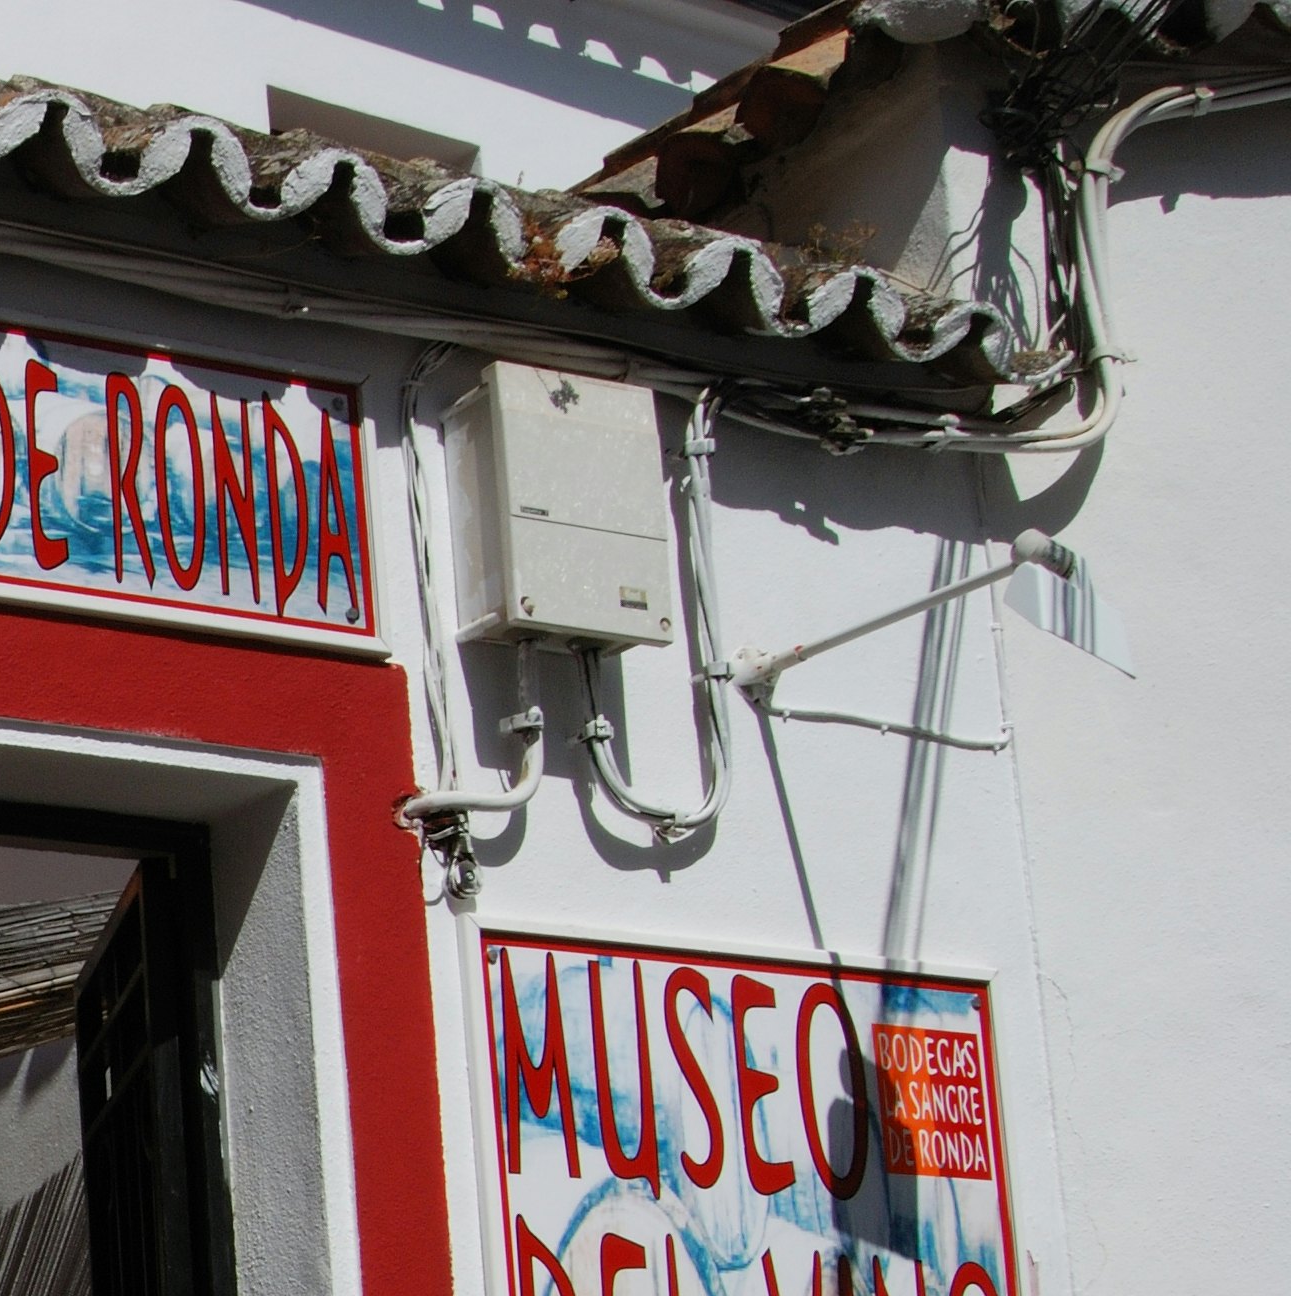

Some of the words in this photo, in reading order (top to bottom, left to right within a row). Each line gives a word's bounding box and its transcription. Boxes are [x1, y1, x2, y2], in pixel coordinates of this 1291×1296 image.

[104, 371, 361, 617] RONDA
[500, 948, 868, 1200] MUSEO
[877, 1032, 977, 1079] BODEGAS
[883, 1079, 907, 1119] LA
[909, 1081, 983, 1126] SANGRE
[888, 1126, 914, 1166] DE
[919, 1129, 988, 1173] RONDA
